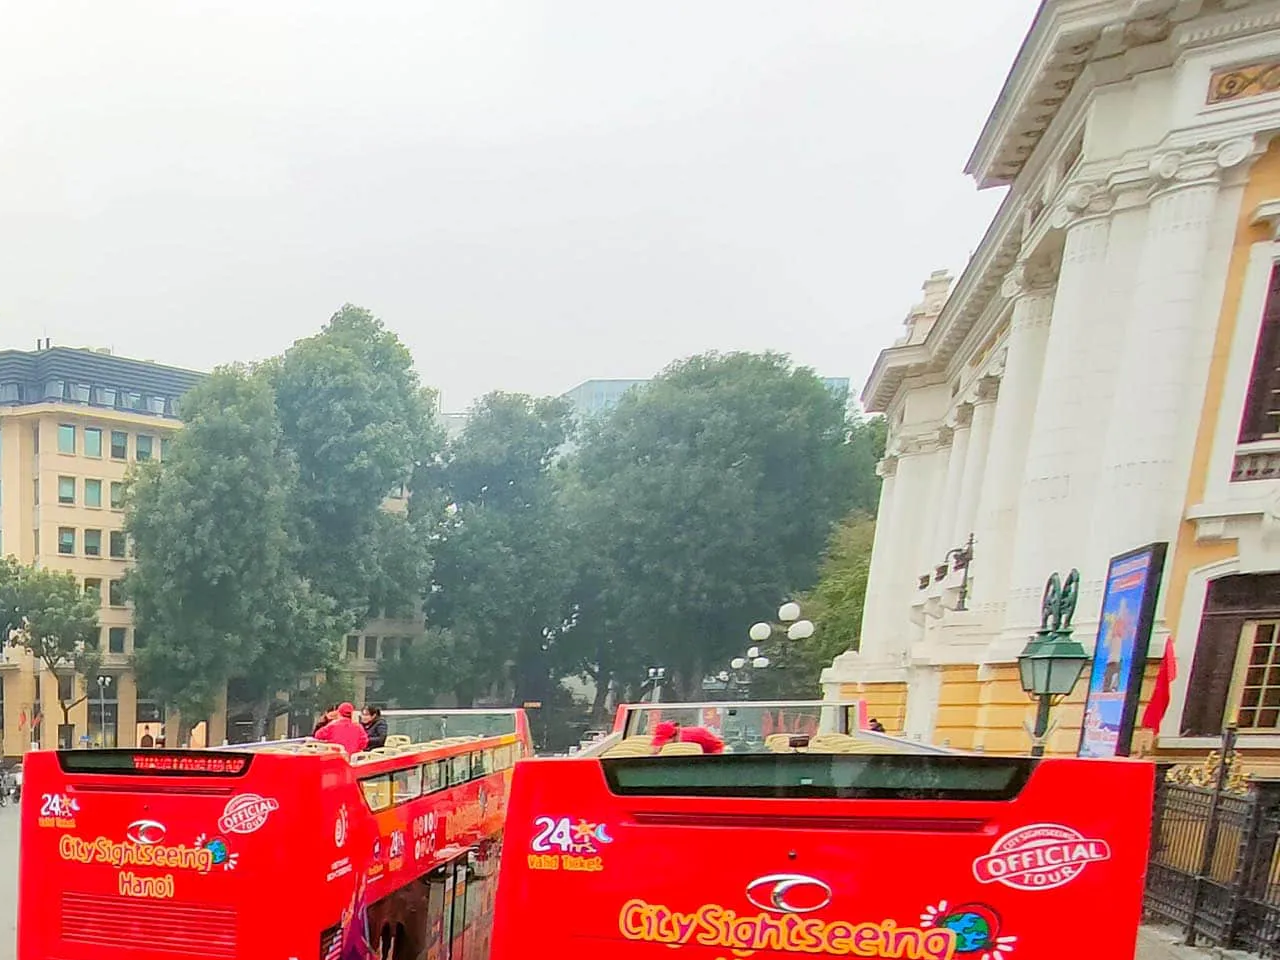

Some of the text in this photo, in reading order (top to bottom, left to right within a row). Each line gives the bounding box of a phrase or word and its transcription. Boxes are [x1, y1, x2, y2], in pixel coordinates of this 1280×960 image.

[223, 800, 275, 828] OFFICIAL
[241, 816, 264, 830] TOUR
[987, 842, 1103, 877] OFFICIAL
[118, 871, 175, 898] Hanoi
[1023, 866, 1075, 885] TOUR
